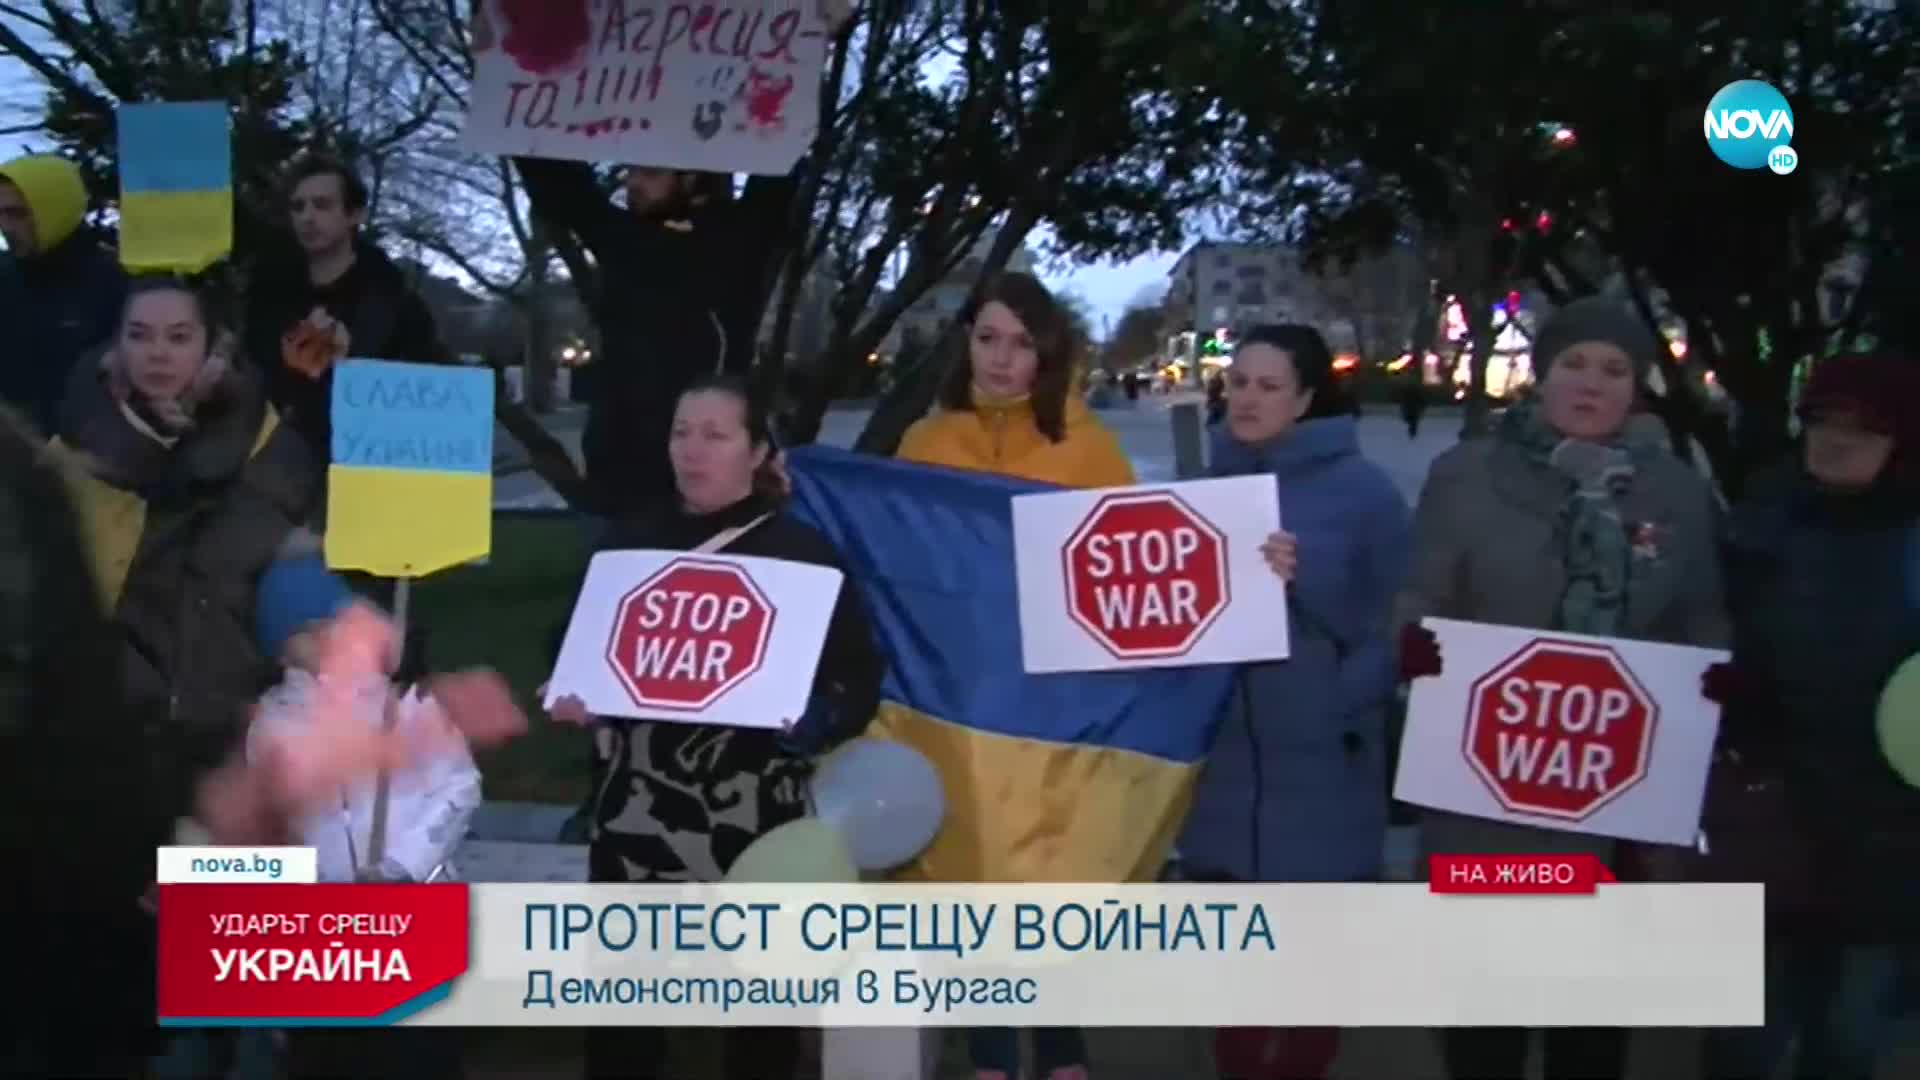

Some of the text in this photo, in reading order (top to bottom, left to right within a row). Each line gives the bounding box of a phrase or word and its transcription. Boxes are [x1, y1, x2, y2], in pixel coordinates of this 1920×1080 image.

[1085, 527, 1200, 579] STOP
[638, 589, 750, 633] STOP
[1095, 578, 1201, 631] WAR
[635, 635, 733, 682] WAR
[1496, 676, 1631, 735] STOP
[1496, 732, 1615, 791] WAR
